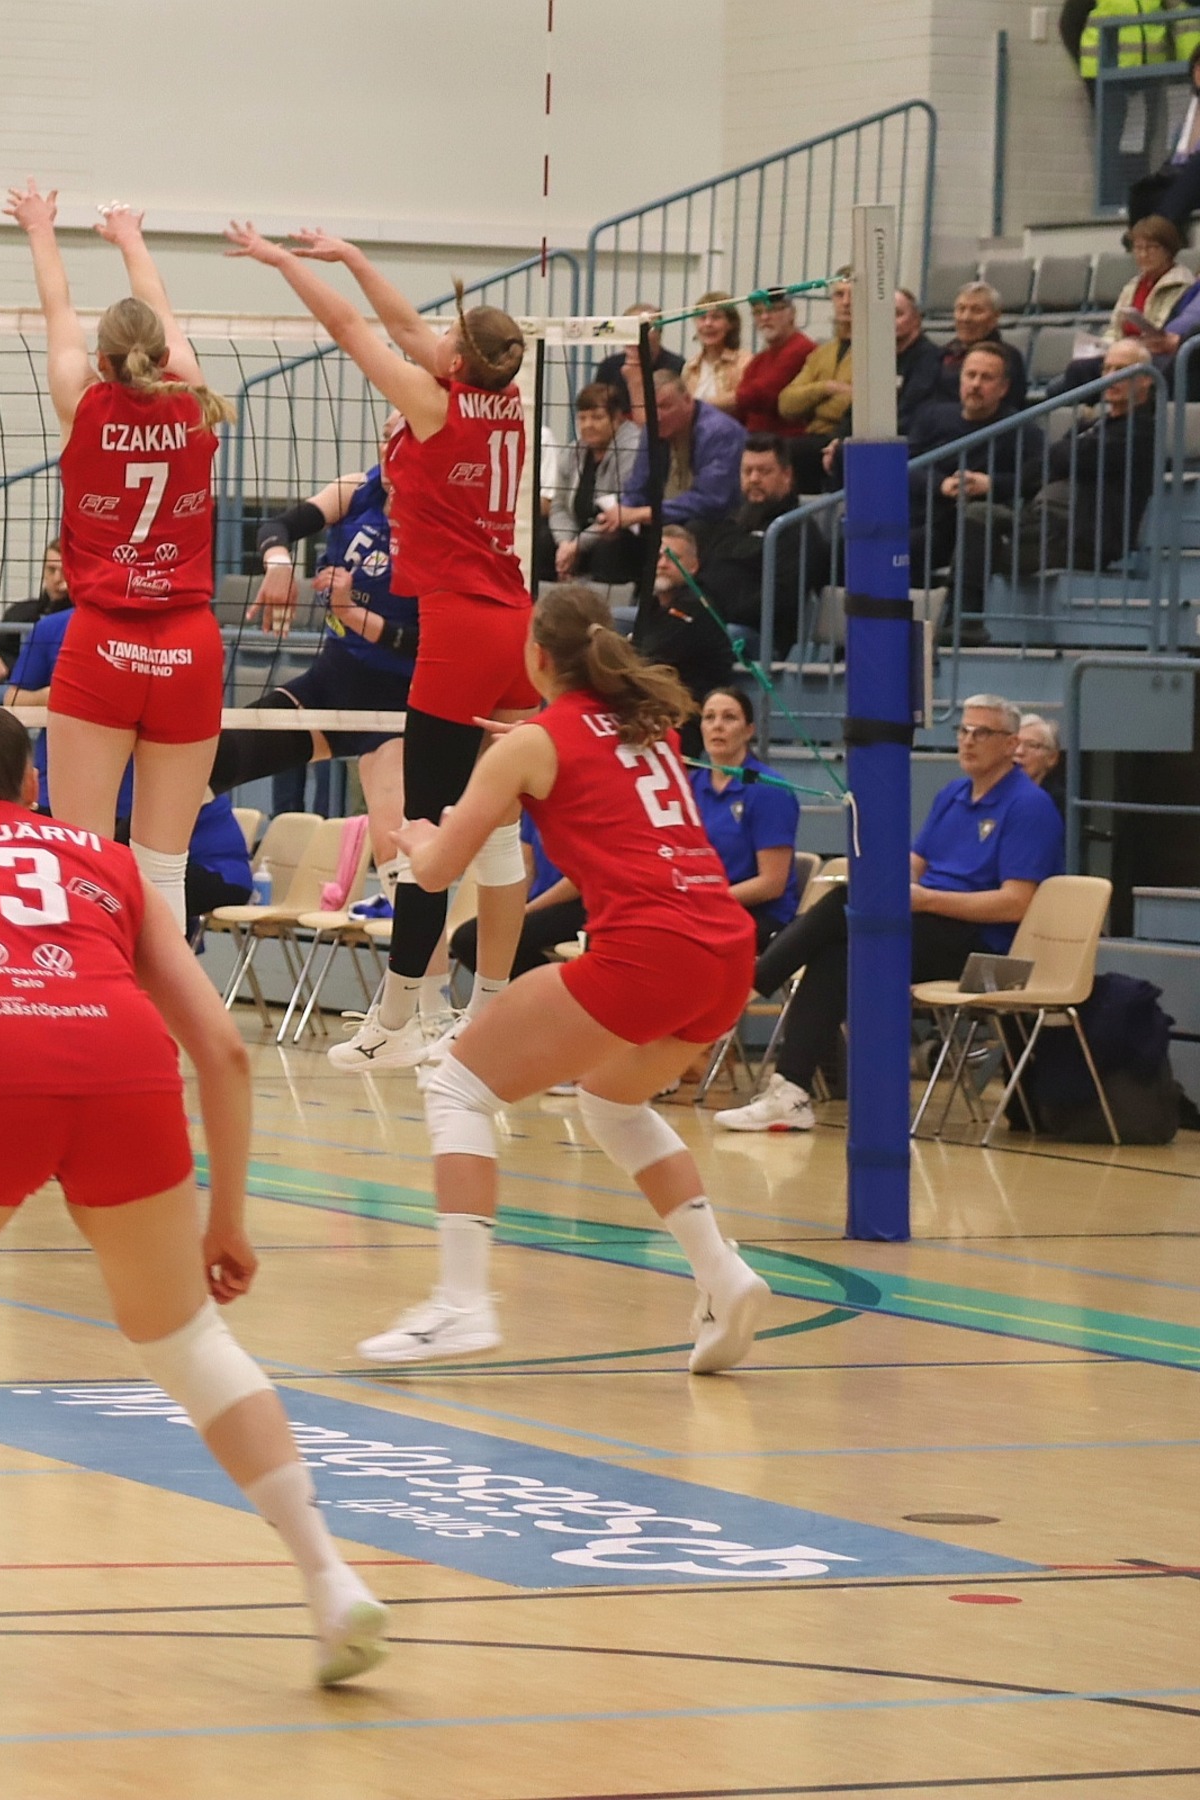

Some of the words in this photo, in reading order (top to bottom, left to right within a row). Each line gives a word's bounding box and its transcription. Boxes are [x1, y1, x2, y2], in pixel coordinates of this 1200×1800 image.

[102, 422, 187, 451] CZAKAN
[487, 430, 520, 512] 11
[125, 462, 169, 543] 7
[344, 531, 373, 575] 5
[107, 640, 192, 665] TAVARATAKSI
[131, 662, 173, 677] FINLAND
[614, 741, 701, 828] 21
[11, 977, 45, 988] Salo
[11, 1386, 723, 1536] Säästöpakki
